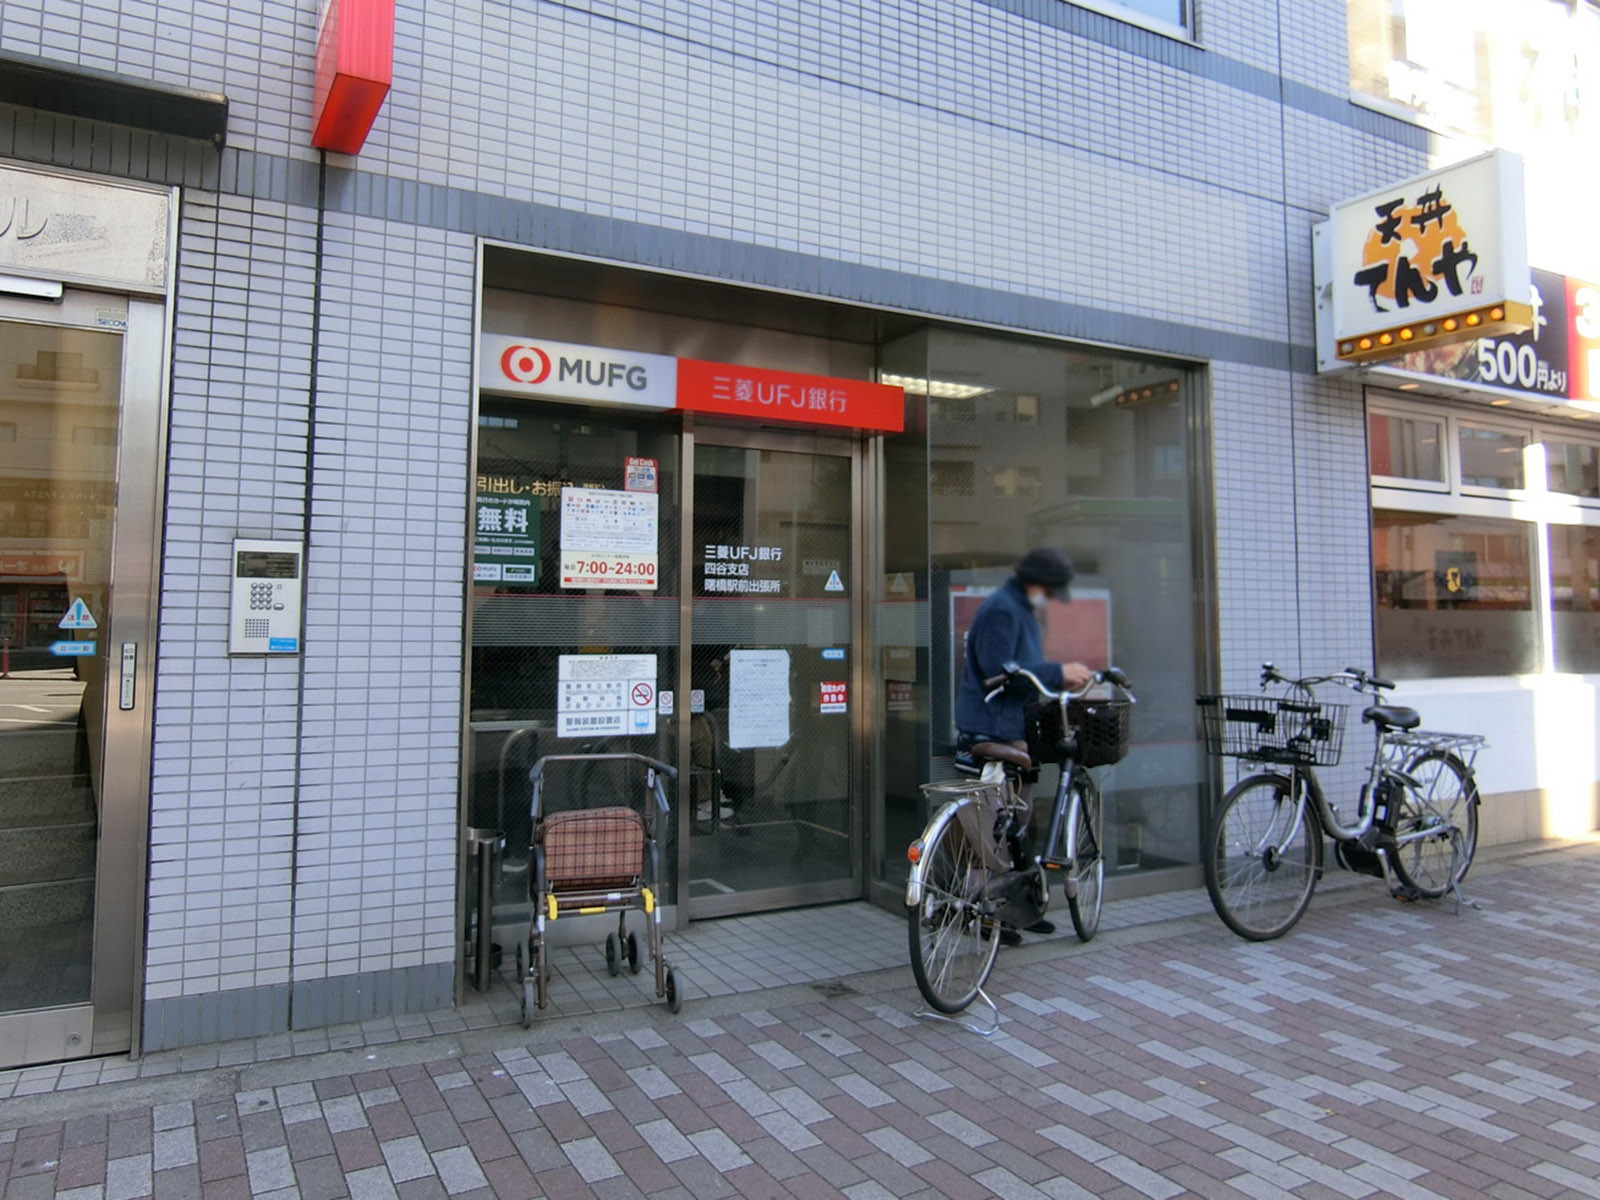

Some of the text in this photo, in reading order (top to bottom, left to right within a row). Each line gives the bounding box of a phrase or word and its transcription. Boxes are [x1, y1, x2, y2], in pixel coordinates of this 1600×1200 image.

[1354, 241, 1478, 312] てんや
[558, 357, 647, 391] MUFG
[712, 376, 847, 413] 三菱UFJ銀行
[478, 506, 529, 533] 無料
[704, 545, 782, 560] 三菱UFJ銀行
[704, 562, 749, 576] 四谷支店
[704, 578, 781, 593] 曙橋駅前出張所
